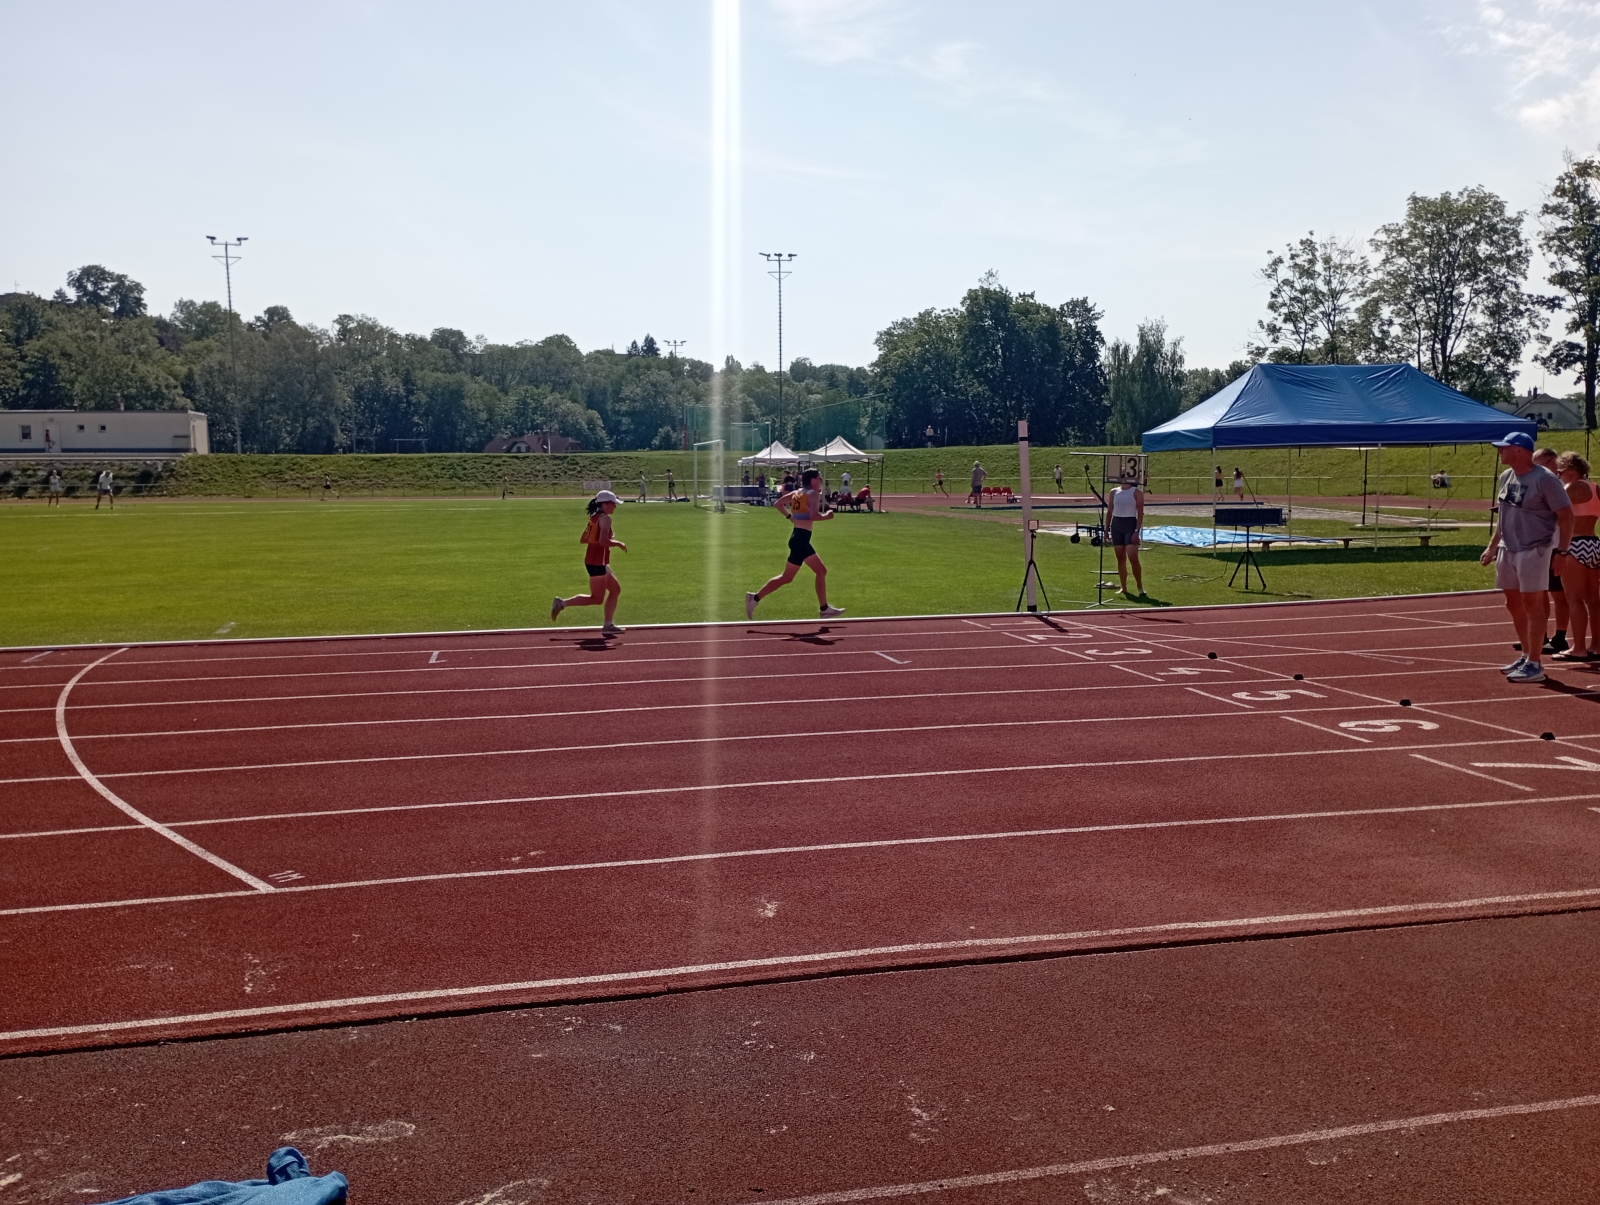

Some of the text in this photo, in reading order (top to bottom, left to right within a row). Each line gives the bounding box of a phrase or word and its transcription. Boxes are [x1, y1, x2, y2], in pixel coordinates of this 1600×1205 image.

[1126, 457, 1138, 478] 3
[1026, 632, 1094, 641] 2
[1084, 647, 1153, 656] 3
[1155, 667, 1235, 676] 4
[1231, 688, 1329, 701] 5
[1338, 718, 1440, 733] 6
